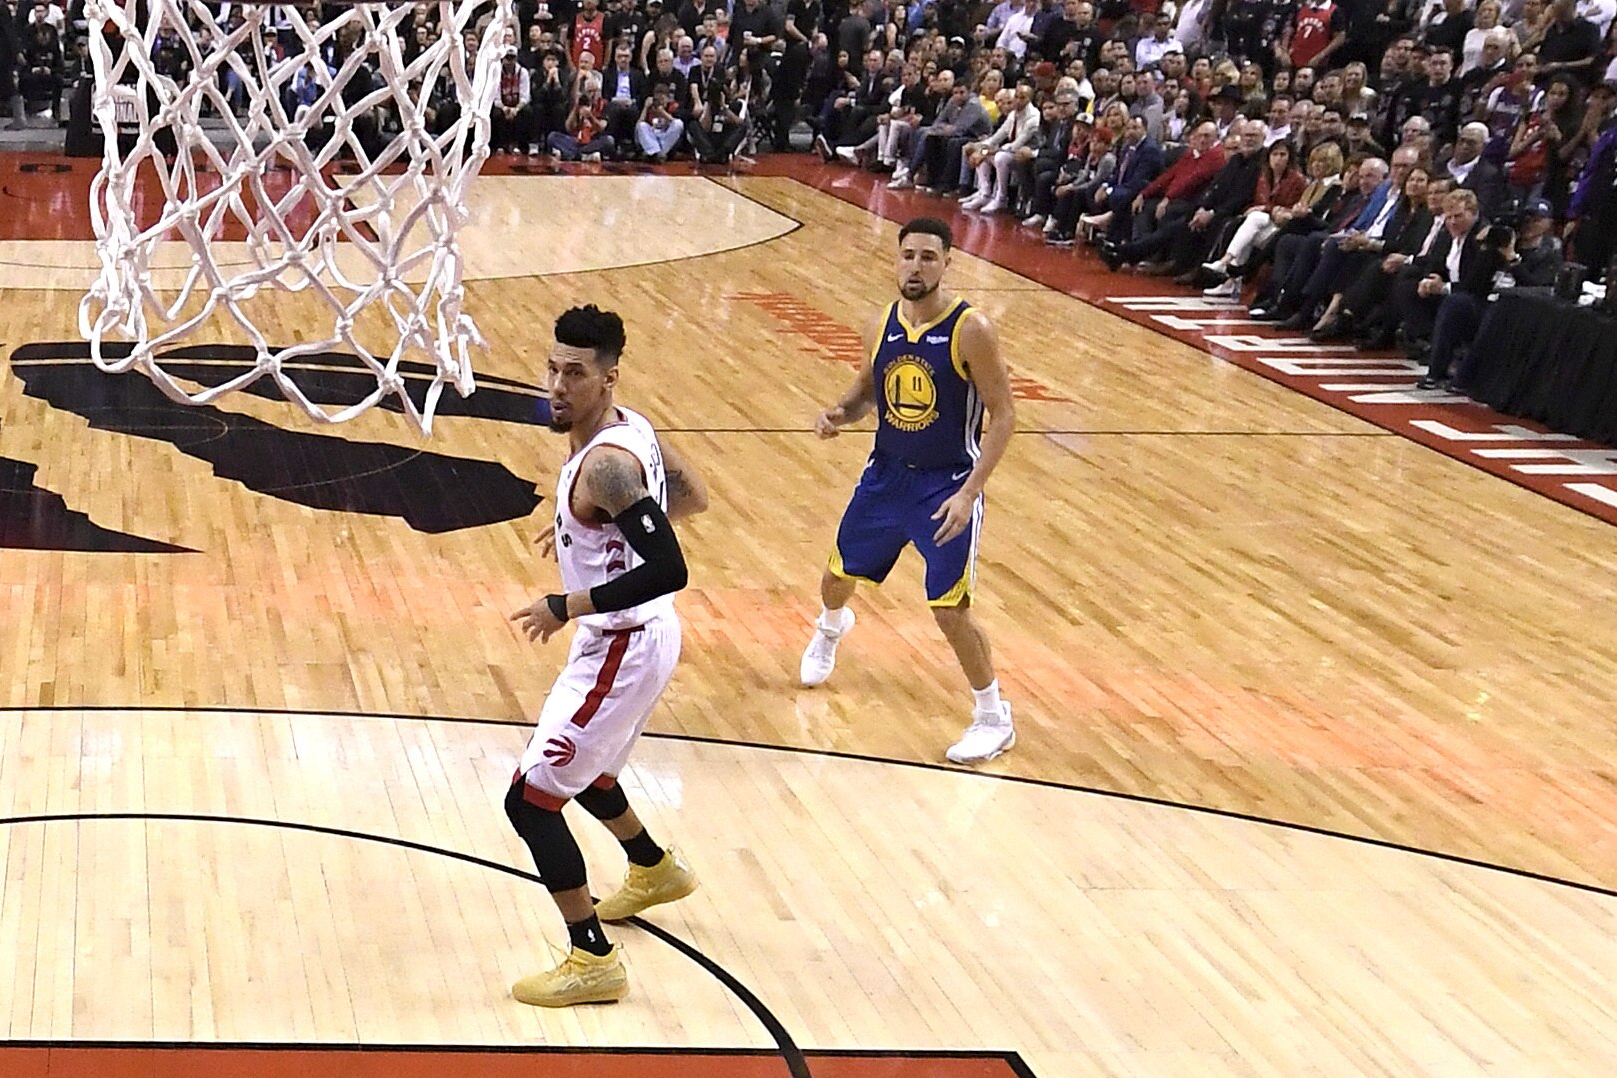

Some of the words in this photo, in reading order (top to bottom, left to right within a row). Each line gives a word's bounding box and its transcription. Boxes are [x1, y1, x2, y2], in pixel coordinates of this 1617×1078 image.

[1303, 25, 1313, 39] 7
[583, 37, 591, 49] 2
[913, 376, 922, 392] 11
[885, 408, 940, 432] WARRIORS
